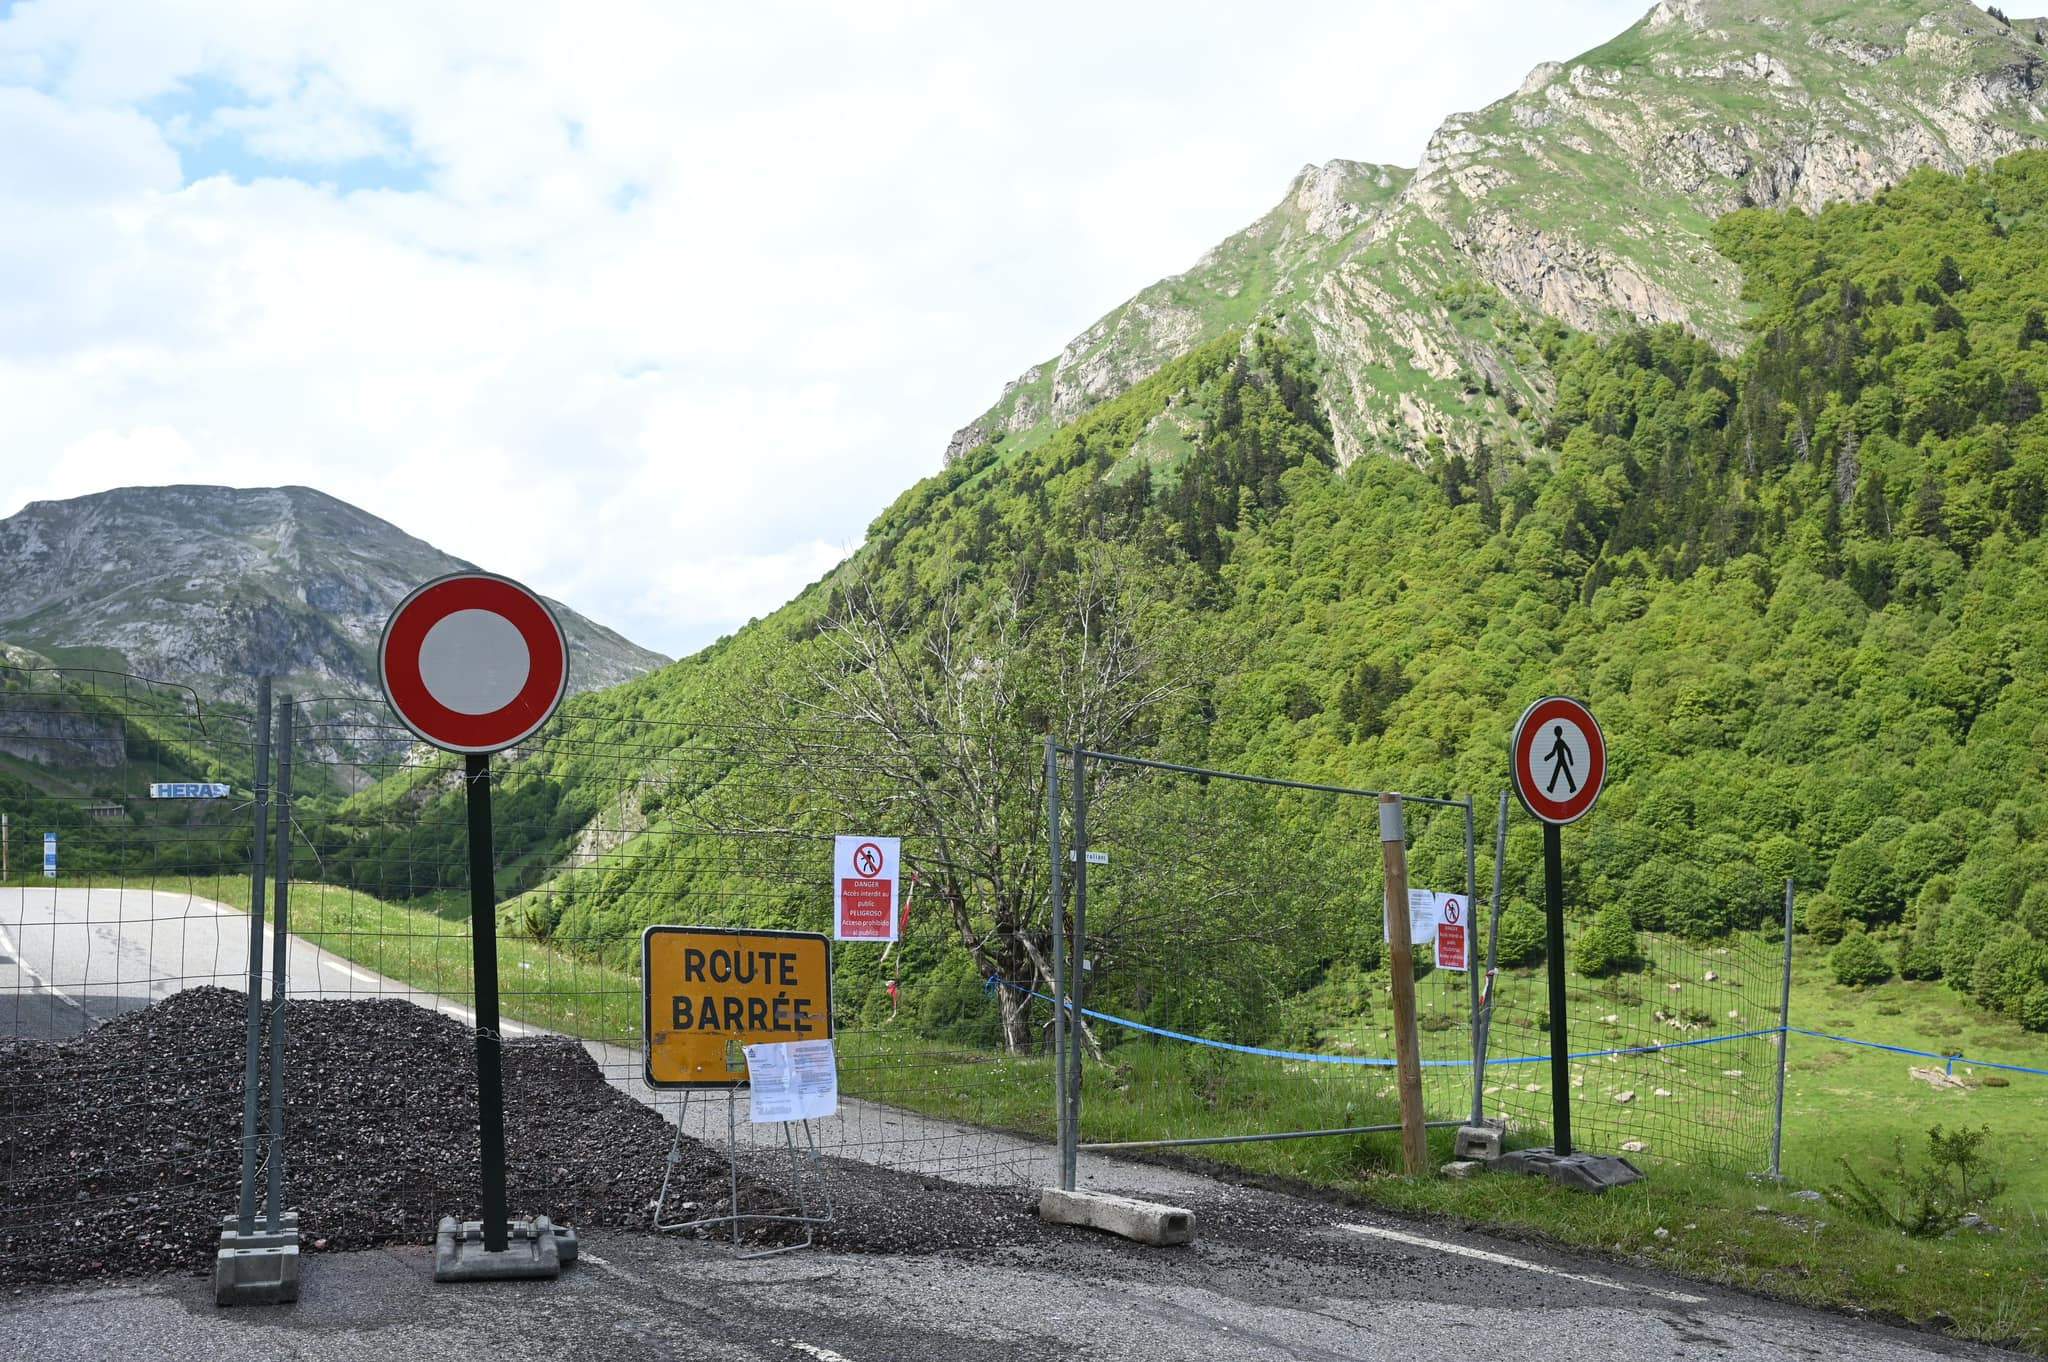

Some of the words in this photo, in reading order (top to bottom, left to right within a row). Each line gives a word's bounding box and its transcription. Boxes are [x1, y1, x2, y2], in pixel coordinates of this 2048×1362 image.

[857, 900, 875, 908] public
[849, 909, 882, 917] PELIGROSO
[862, 919, 890, 927] prohibido
[684, 948, 798, 986] ROUTE
[672, 991, 814, 1032] BARRÉE
